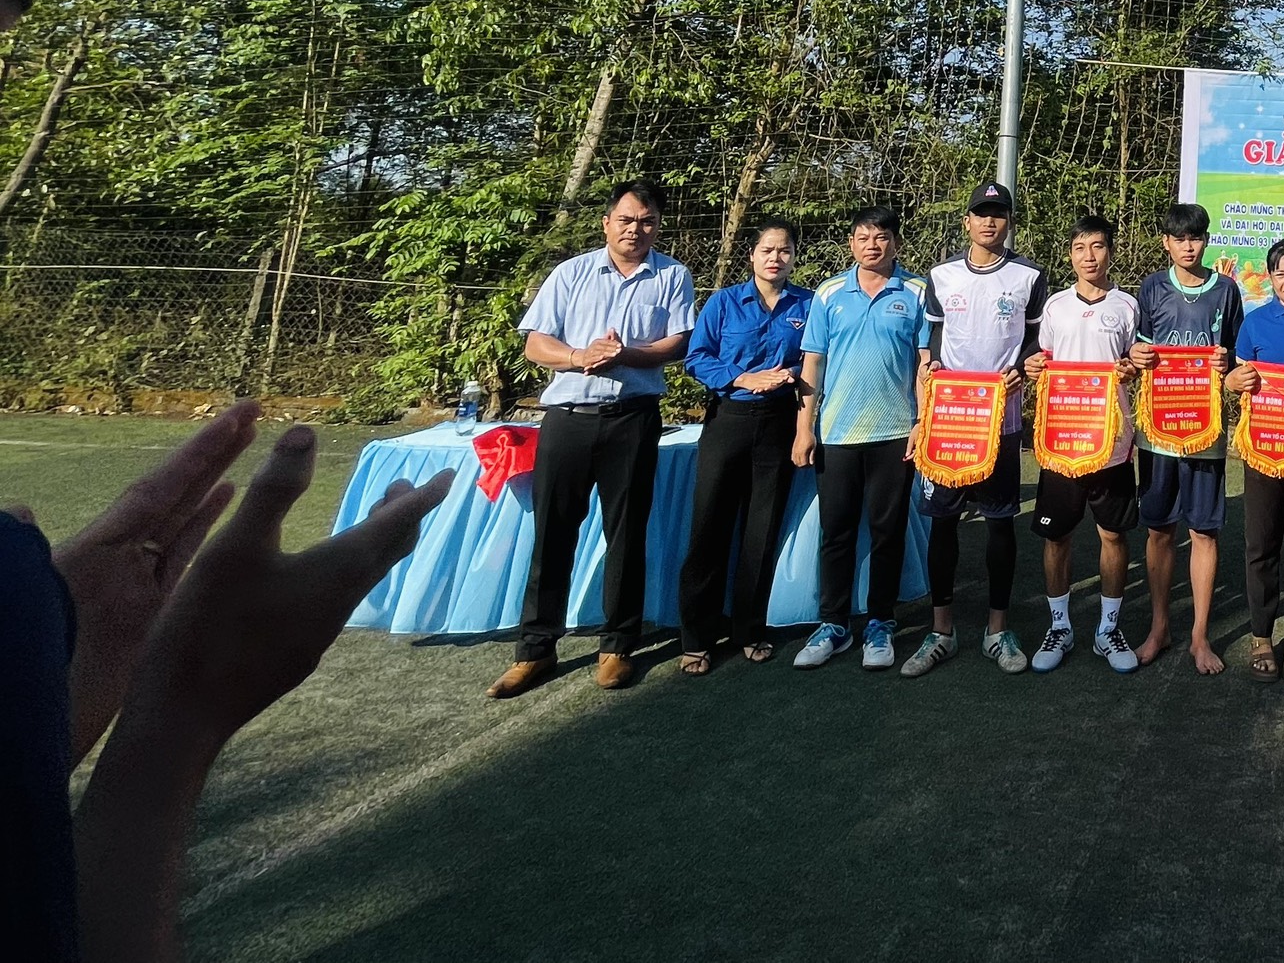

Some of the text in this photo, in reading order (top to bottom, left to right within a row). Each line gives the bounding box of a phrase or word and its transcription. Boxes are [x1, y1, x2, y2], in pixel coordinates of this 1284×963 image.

[1224, 203, 1247, 214] CHÀO
[1209, 233, 1228, 245] HÀO
[1259, 237, 1268, 246] 93
